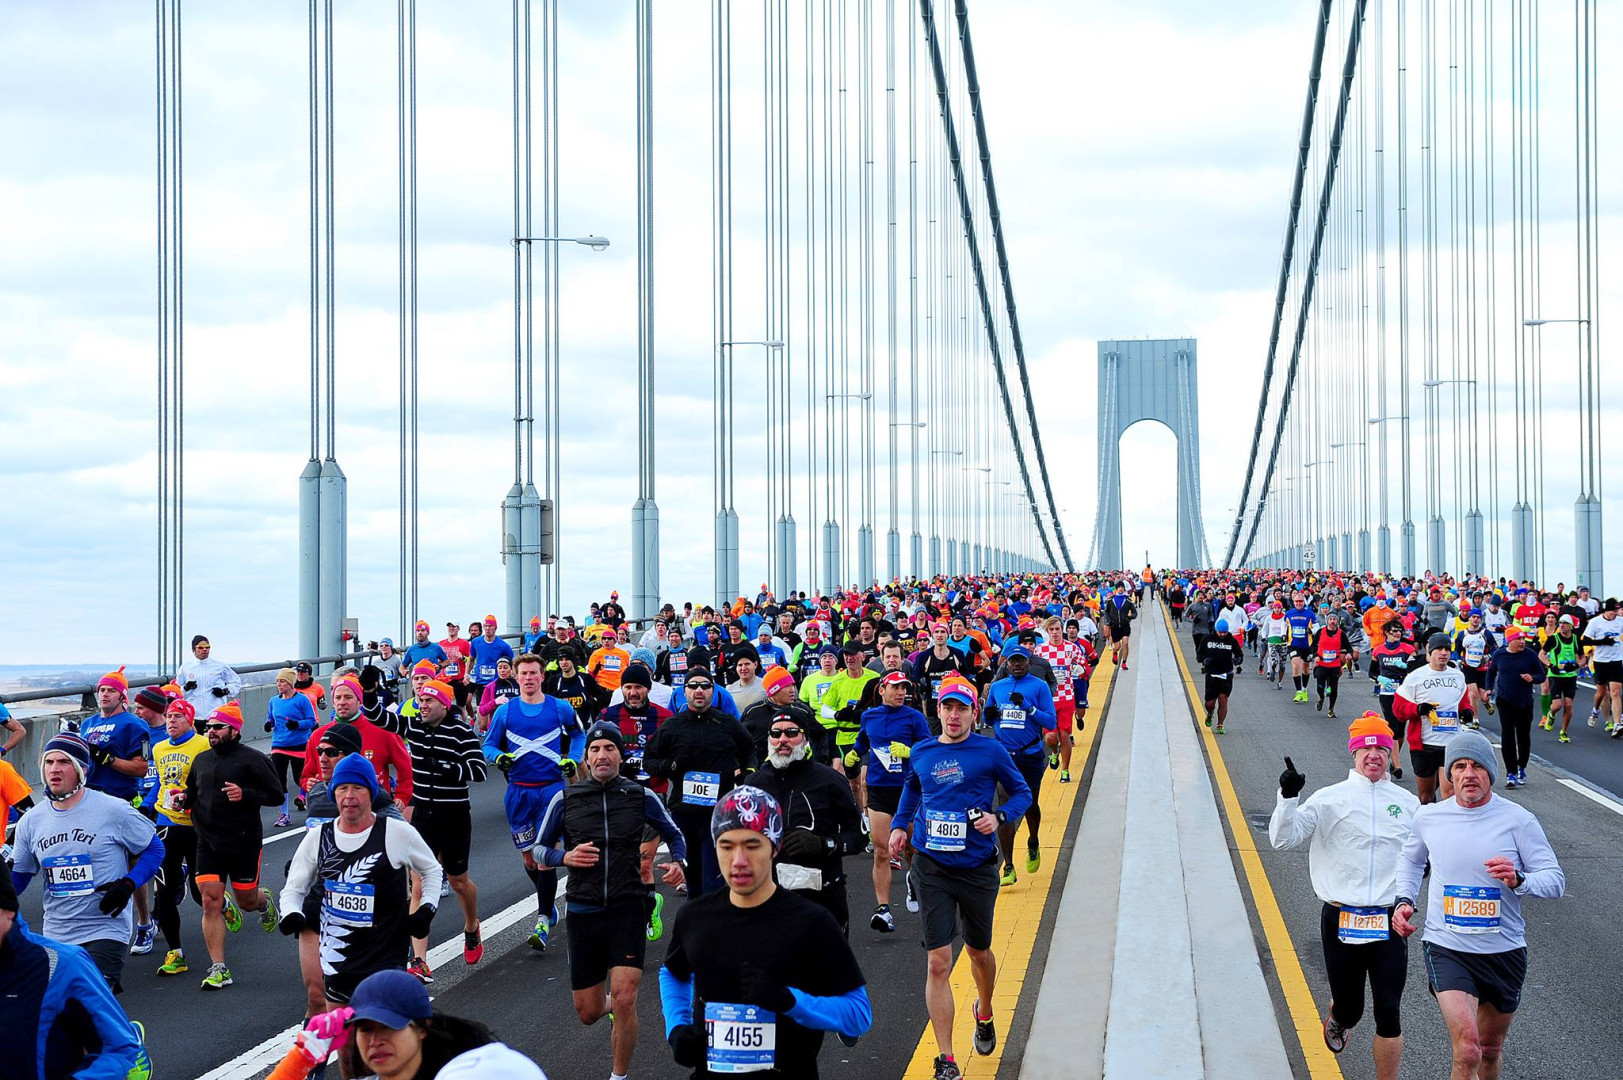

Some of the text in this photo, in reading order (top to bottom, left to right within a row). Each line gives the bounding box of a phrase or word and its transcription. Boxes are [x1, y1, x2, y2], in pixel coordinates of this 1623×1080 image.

[1422, 678, 1459, 690] CARLOS
[1005, 711, 1023, 719] 4406
[160, 753, 190, 767] SVERIGE
[692, 783, 710, 796] JOE
[936, 823, 960, 837] 4813
[37, 828, 97, 852] Team Teri
[59, 867, 87, 882] 4664
[337, 895, 368, 912] 4638
[1458, 900, 1497, 917] 12589
[1353, 914, 1385, 929] 12762
[724, 1026, 763, 1048] 4155
